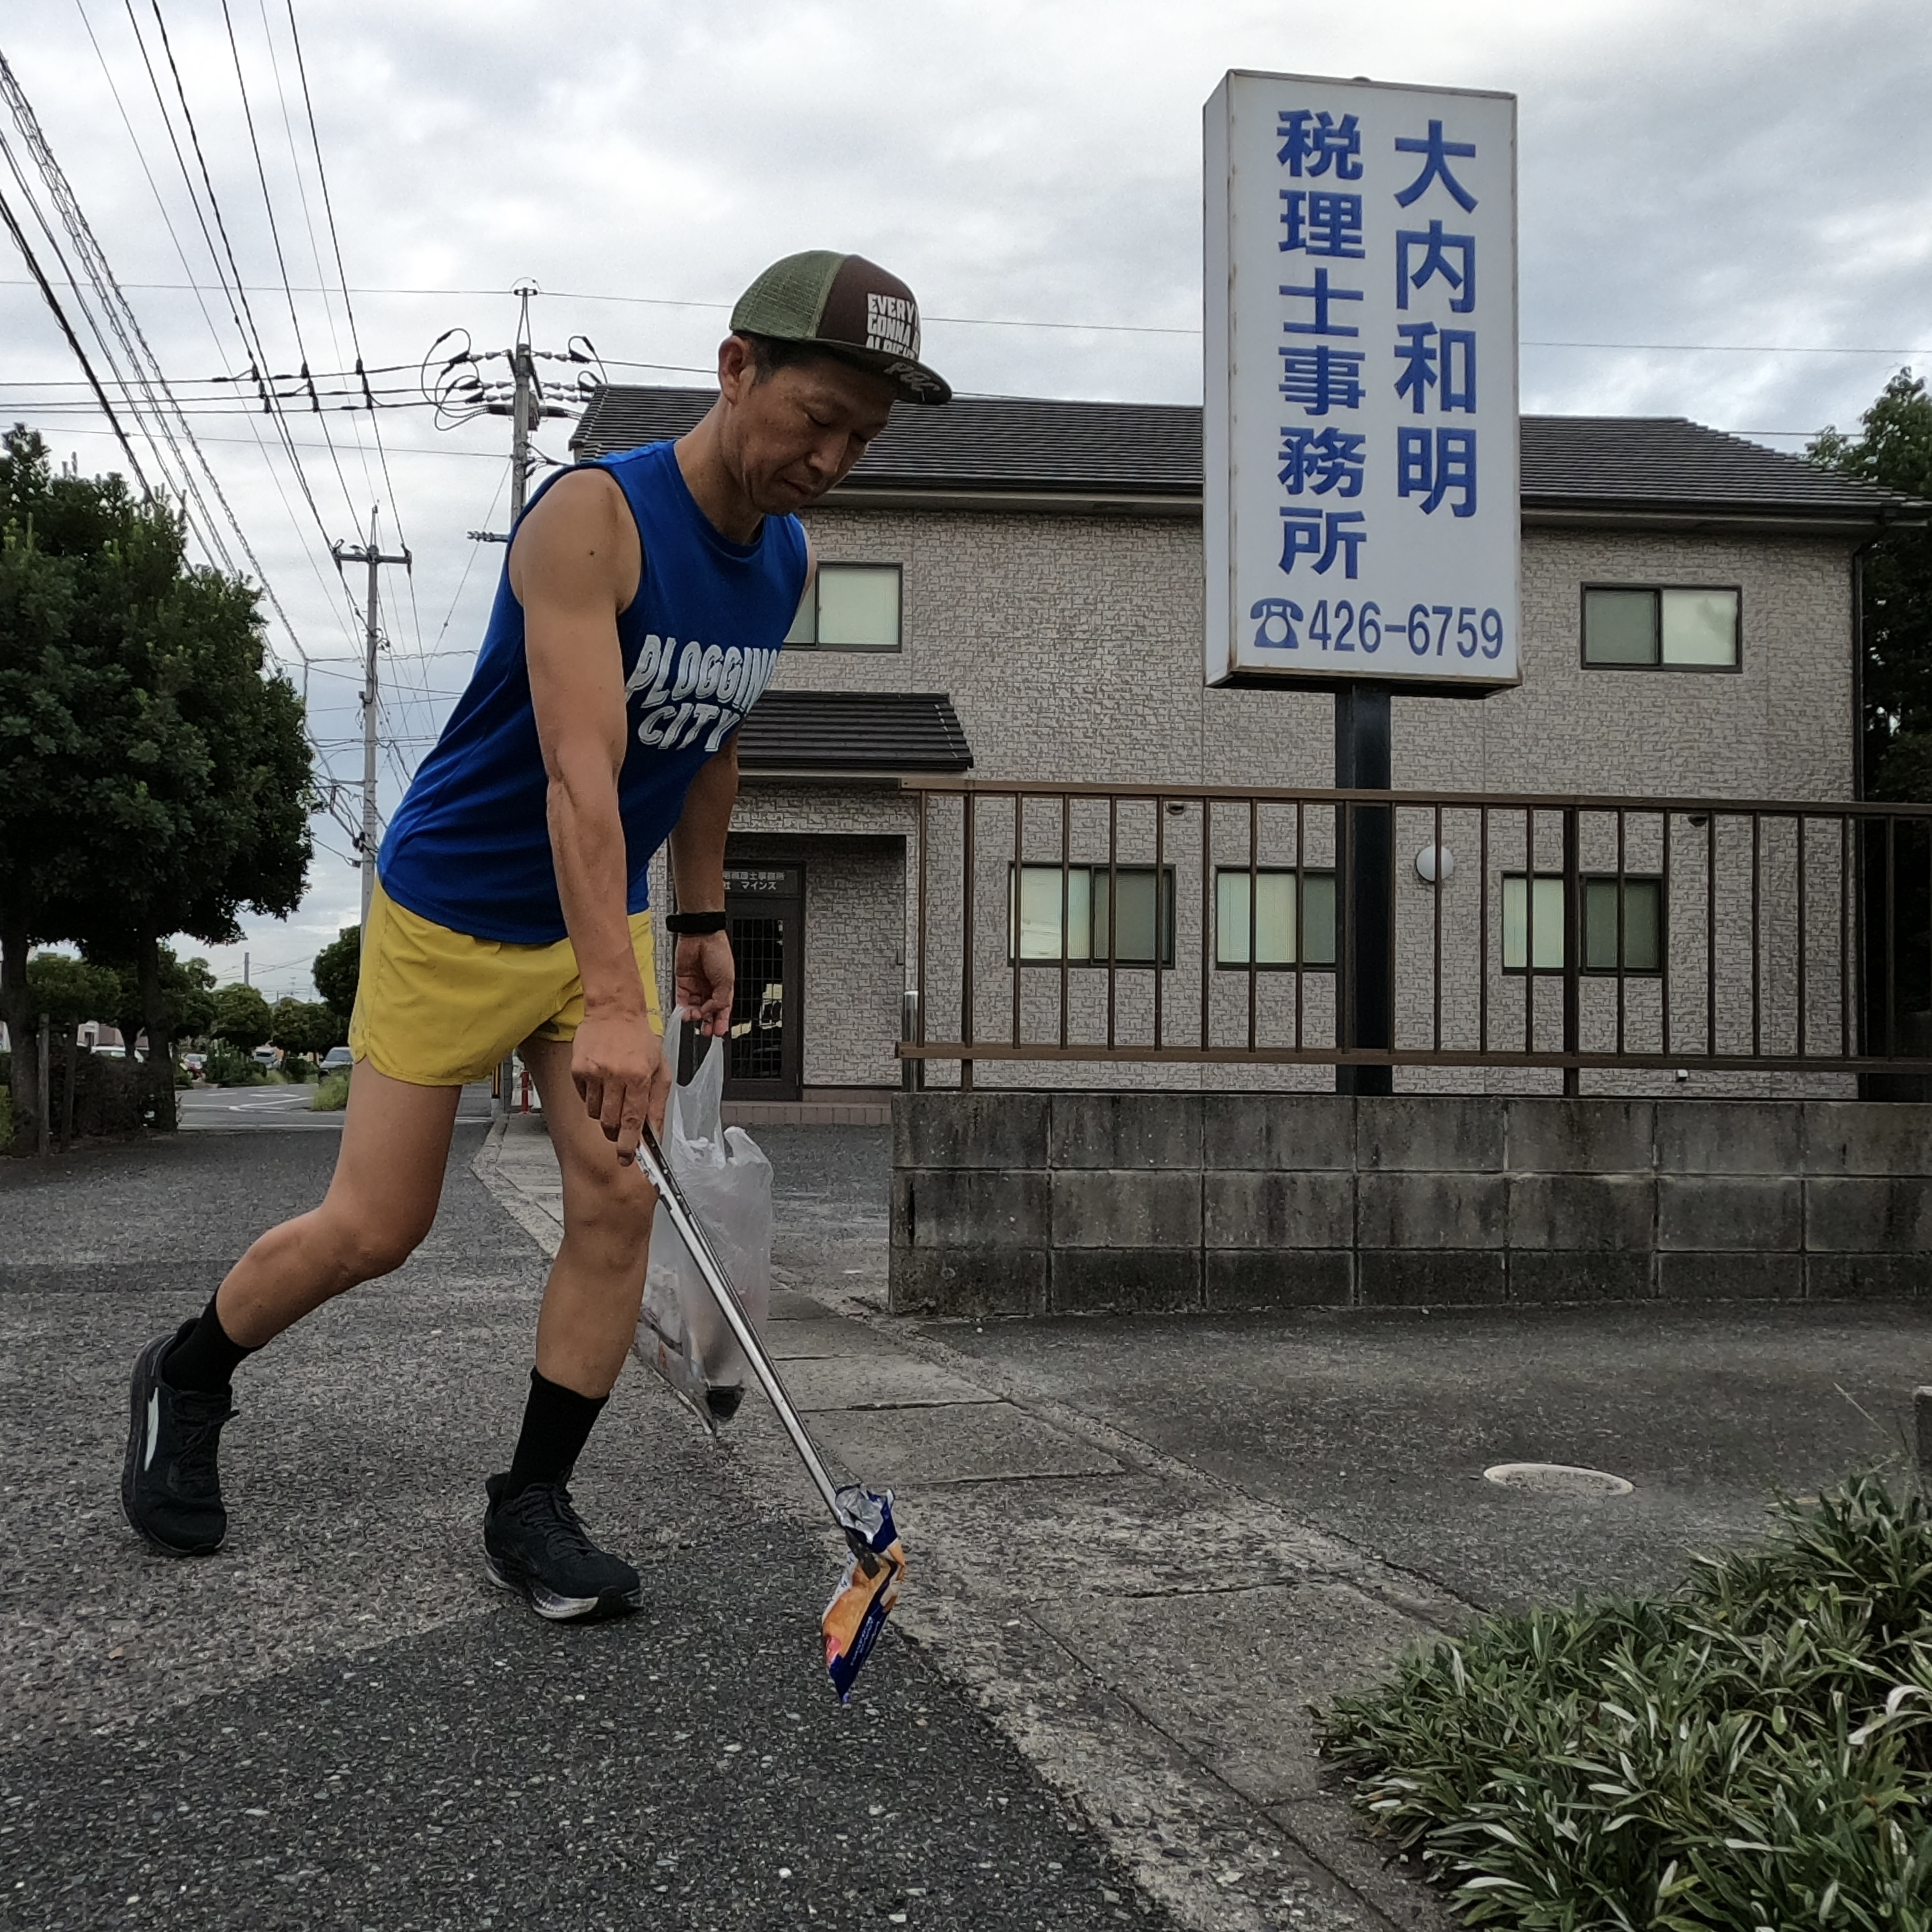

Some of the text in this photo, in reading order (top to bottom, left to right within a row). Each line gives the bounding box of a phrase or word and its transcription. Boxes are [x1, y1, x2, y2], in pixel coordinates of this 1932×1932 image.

[867, 313, 911, 347] GONNA
[1276, 109, 1366, 579] 税理士事務所
[1394, 119, 1478, 518] 大内和明
[1308, 599, 1503, 659] 426-6759
[638, 703, 740, 752] CITY
